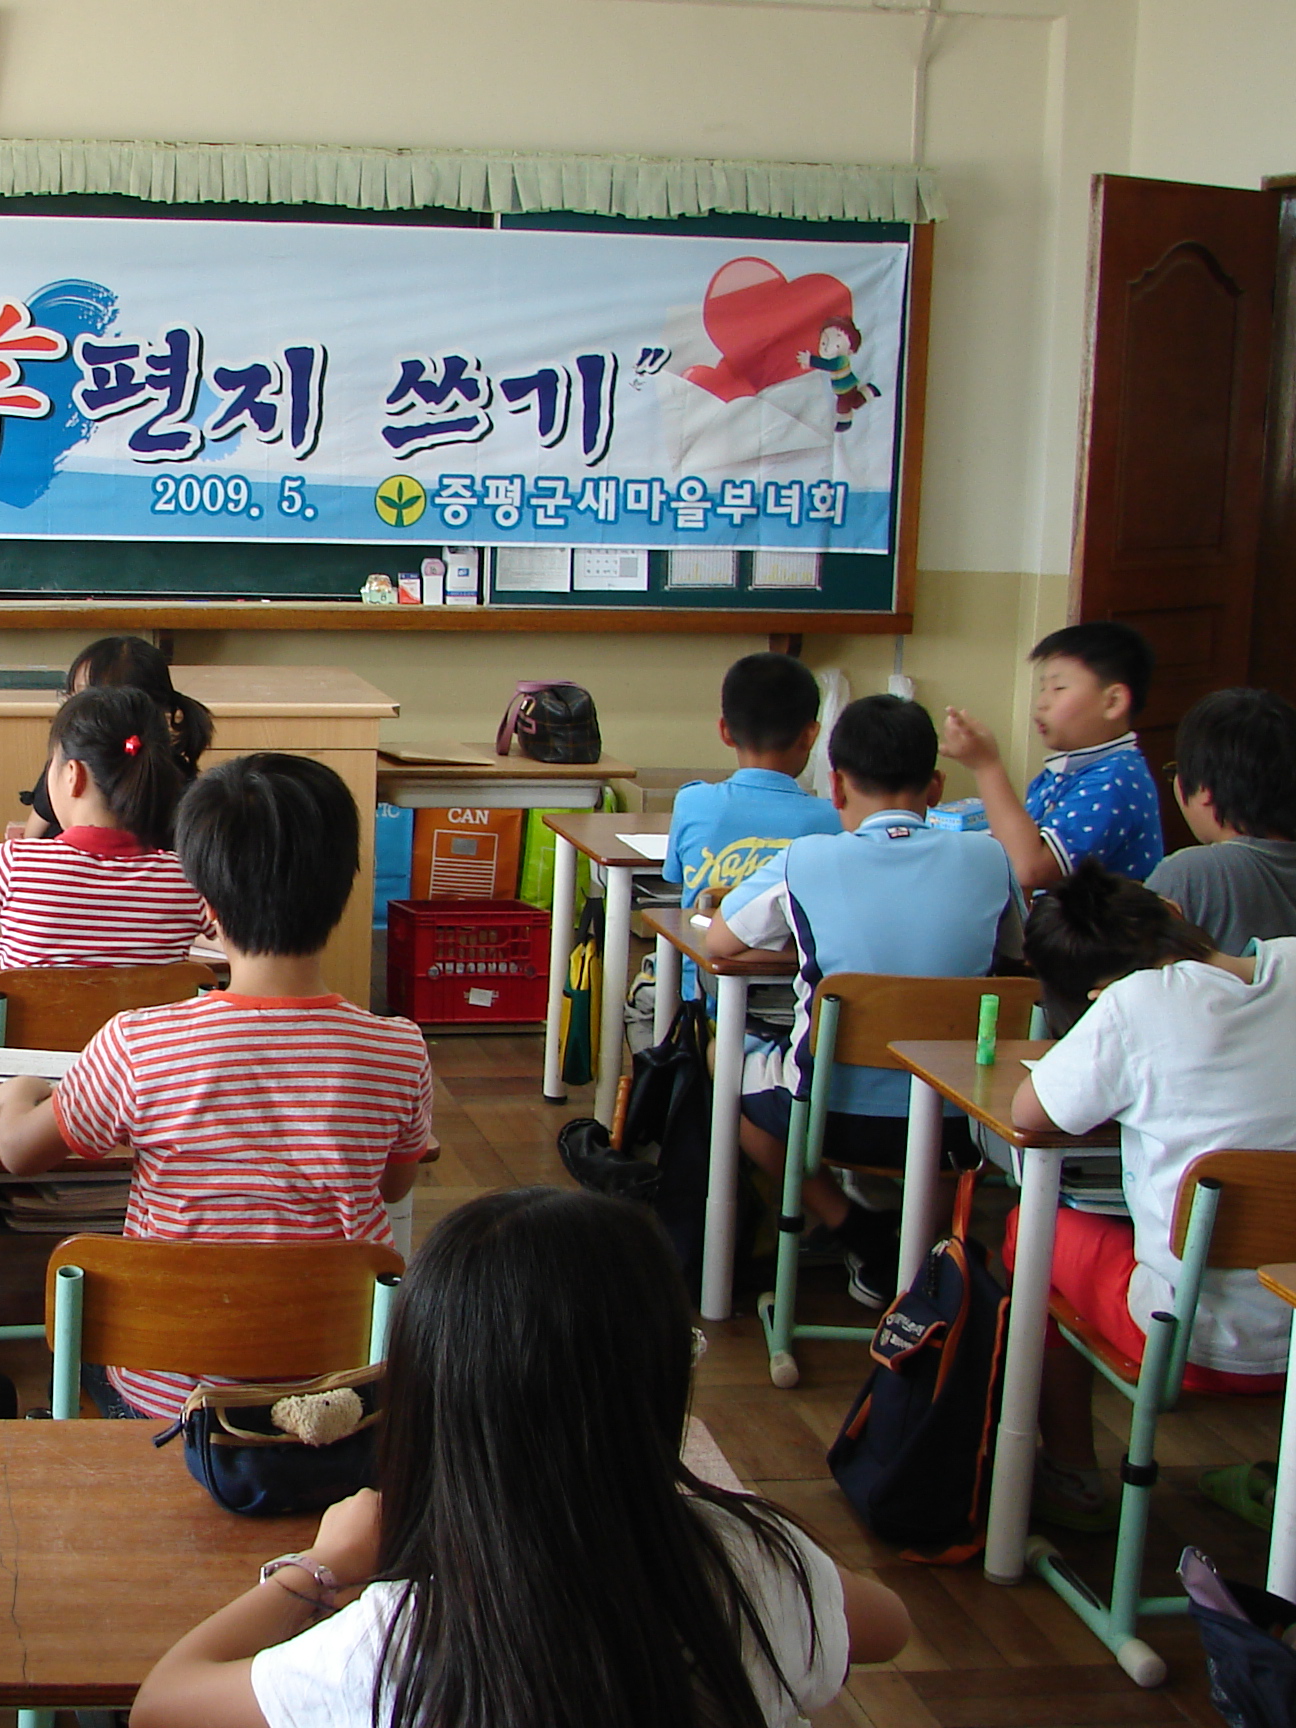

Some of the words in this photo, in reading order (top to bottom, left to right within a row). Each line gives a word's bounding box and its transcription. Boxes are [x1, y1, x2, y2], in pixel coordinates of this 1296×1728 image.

[154, 476, 261, 518] 2009.
[280, 478, 316, 519] 5.
[447, 808, 489, 824] CAN
